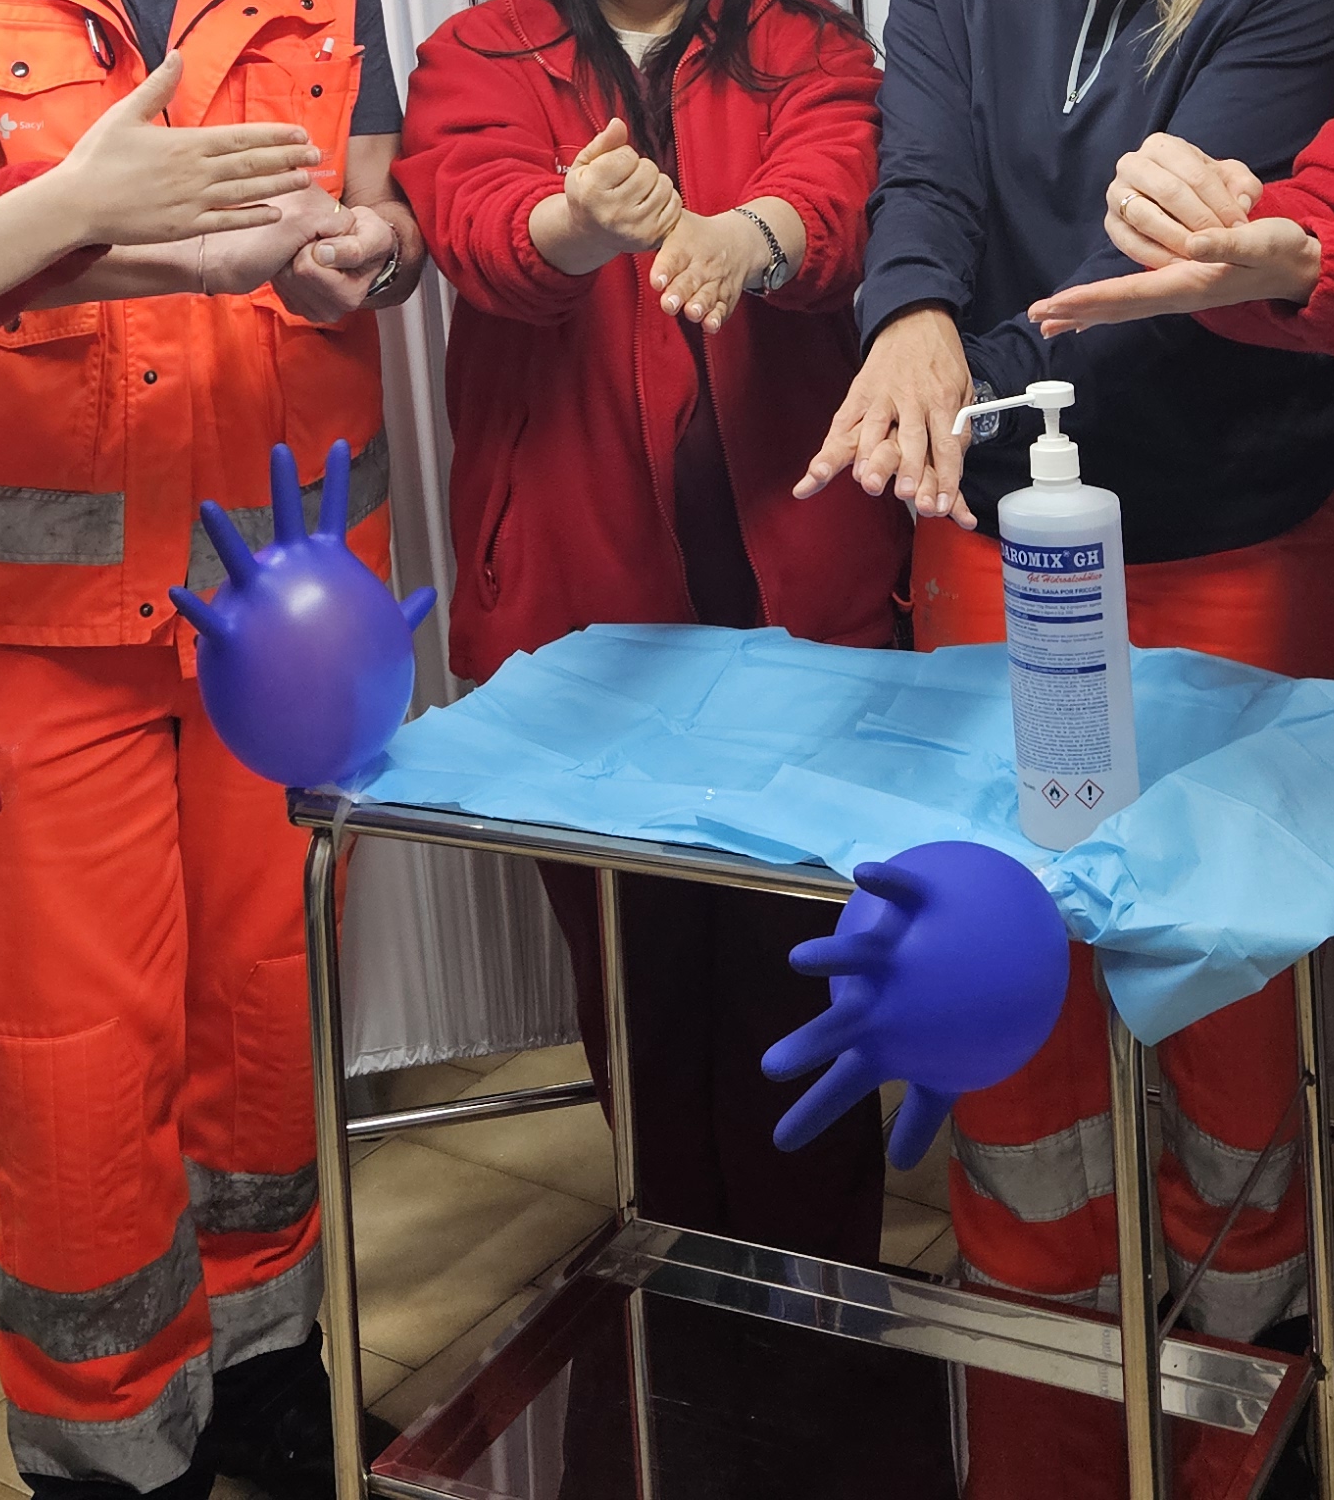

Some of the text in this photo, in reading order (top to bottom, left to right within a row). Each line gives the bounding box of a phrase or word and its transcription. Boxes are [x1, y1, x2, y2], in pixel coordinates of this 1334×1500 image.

[19, 119, 45, 131] Sacyl
[1073, 549, 1100, 568] GH
[1027, 572, 1039, 584] Gel
[1041, 572, 1103, 584] Hidroalcohólico
[1075, 585, 1102, 594] FRICCIÓN
